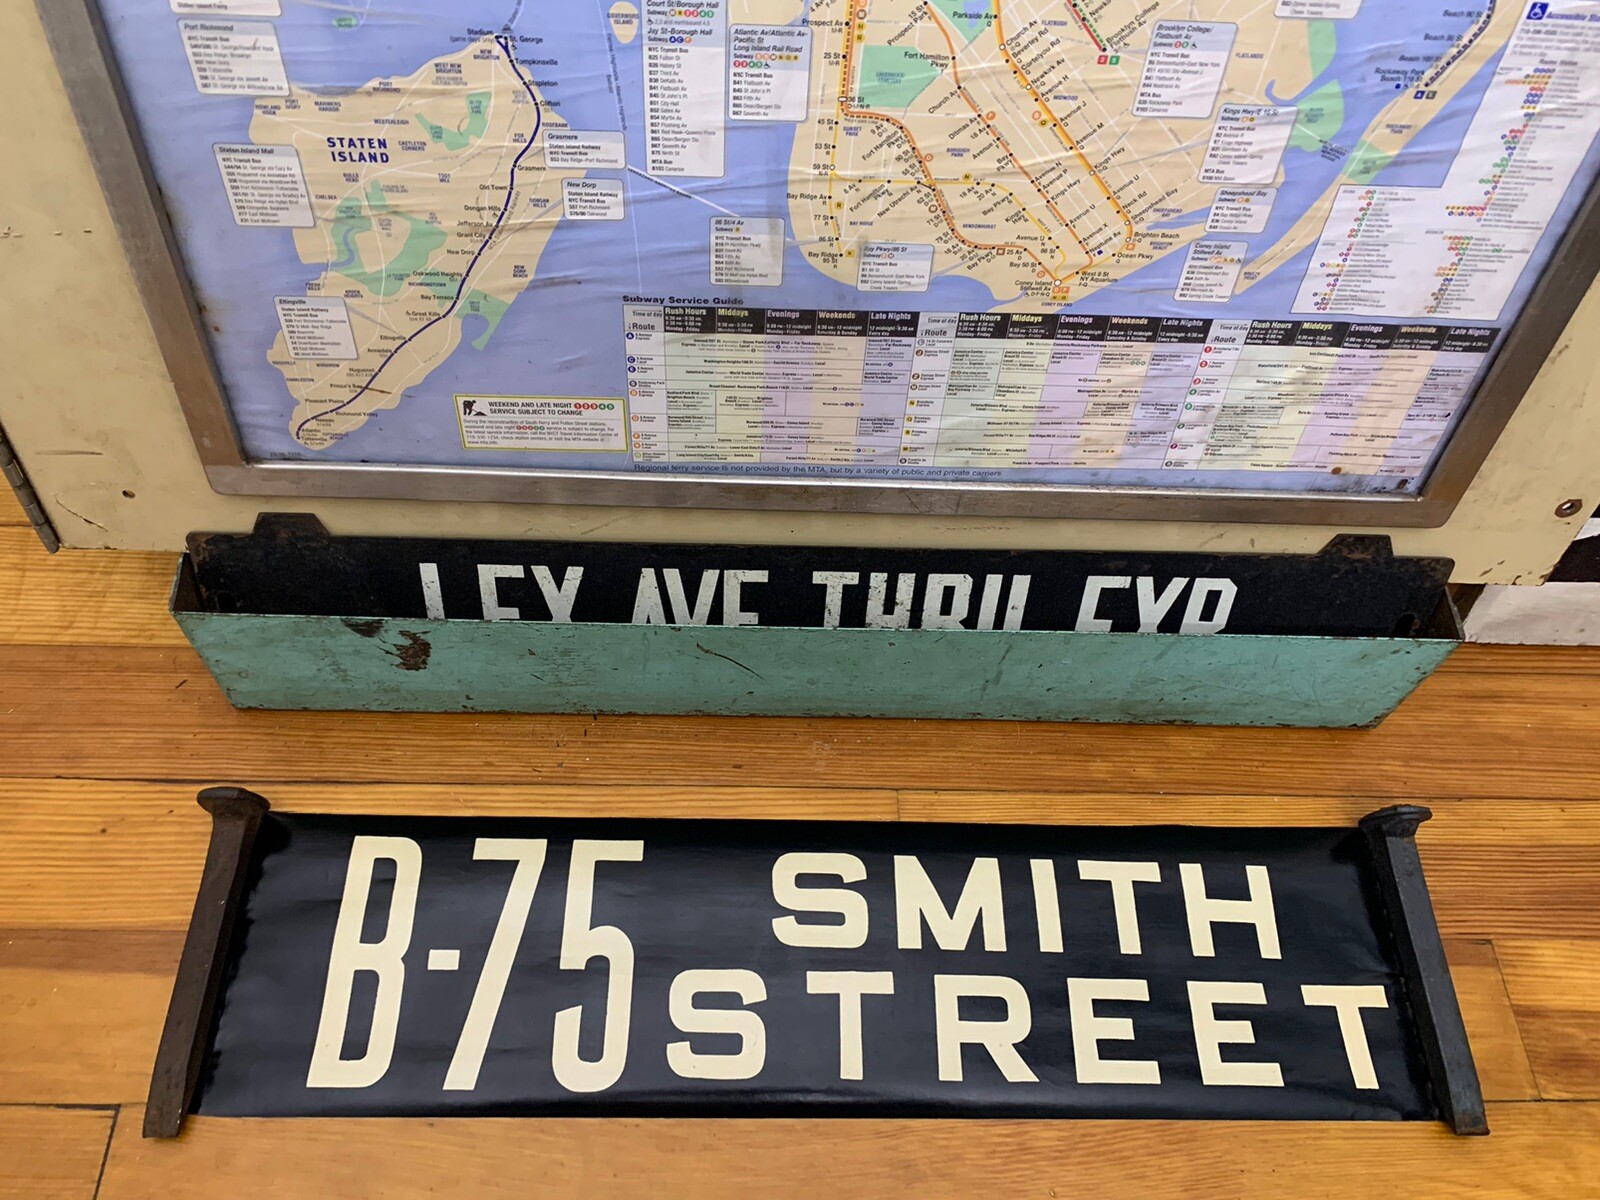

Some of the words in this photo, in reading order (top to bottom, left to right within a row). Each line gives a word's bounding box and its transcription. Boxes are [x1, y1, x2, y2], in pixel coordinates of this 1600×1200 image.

[952, 11, 981, 20] Parkside
[801, 18, 833, 28] Prospect
[1105, 20, 1135, 44] Brooklyn
[1134, 2, 1160, 21] College
[183, 23, 198, 32] Port
[199, 23, 234, 33] Richmond
[647, 28, 659, 36] Jay
[698, 28, 713, 36] Hall
[733, 28, 758, 36] Atlantic
[759, 28, 795, 37] Av/Atlantic
[1156, 24, 1185, 32] Brooklyn
[1109, 26, 1139, 50] Flatbush
[1137, 18, 1147, 28] Av
[1155, 32, 1182, 40] Flatbush
[519, 35, 543, 44] George
[733, 36, 754, 44] Pacific
[733, 44, 748, 53] Long
[749, 44, 769, 52] Island
[787, 45, 803, 53] Road
[919, 52, 950, 61] Hamilton
[930, 60, 948, 69] Pkwy
[1374, 67, 1404, 76] Rockaway
[1406, 68, 1425, 76] Park
[527, 79, 558, 87] Stapleton
[548, 133, 578, 141] Grasmere
[326, 136, 388, 149] STATEN
[218, 146, 239, 154] Staten
[240, 147, 261, 155] Island
[331, 150, 390, 163] ISLAND
[517, 165, 546, 173] Grasmere
[566, 180, 581, 188] New
[582, 181, 597, 190] Dorp
[1220, 189, 1254, 198] Sheepshead
[1254, 189, 1268, 198] Bay
[877, 207, 891, 218] New
[891, 192, 912, 211] Utrecht
[1131, 195, 1166, 221] Sheepshead
[1165, 187, 1178, 198] Bay
[464, 205, 485, 213] Dongan
[456, 220, 483, 228] Jefferson
[456, 231, 471, 239] Grant
[471, 231, 486, 239] City
[459, 249, 475, 257] Dorp
[808, 251, 819, 259] Bay
[441, 271, 463, 279] Heights
[420, 294, 431, 302] Bay
[622, 295, 665, 304] Subway
[668, 295, 709, 304] Service
[712, 297, 744, 305] Guide
[664, 307, 685, 316] Rush
[686, 307, 707, 316] Hours
[717, 308, 749, 317] Middays
[767, 311, 800, 319] Evenings
[818, 311, 856, 320] Weekends
[870, 312, 887, 320] Late
[887, 313, 912, 321] Nights
[960, 313, 978, 322] Rush
[979, 314, 1001, 322] Hours
[1011, 314, 1043, 323] Middays
[1060, 315, 1093, 324] Evenings
[1111, 316, 1148, 325] Weekends
[631, 322, 656, 330] Route
[1162, 318, 1179, 326] Late
[1181, 318, 1204, 327] Nights
[1251, 321, 1270, 329] Rush
[1271, 322, 1293, 330] Hours
[1302, 322, 1333, 331] Middays
[924, 329, 948, 337] Route
[1350, 324, 1383, 333] Evenings
[1400, 325, 1437, 334] Weekends
[1450, 327, 1466, 335] Late
[1467, 328, 1491, 337] Nights
[1213, 335, 1237, 344] Route
[634, 463, 669, 471] Regional
[671, 463, 689, 472] ferry
[721, 464, 729, 472] is
[731, 464, 744, 472] not
[746, 465, 779, 474] provided
[781, 465, 792, 474] by
[807, 465, 828, 474] MTA,
[844, 467, 854, 476] by
[901, 468, 925, 477] public
[943, 469, 970, 477] private
[772, 853, 1281, 960] SMITH
[306, 836, 643, 1092] B-75
[667, 969, 1388, 1090] STREET
